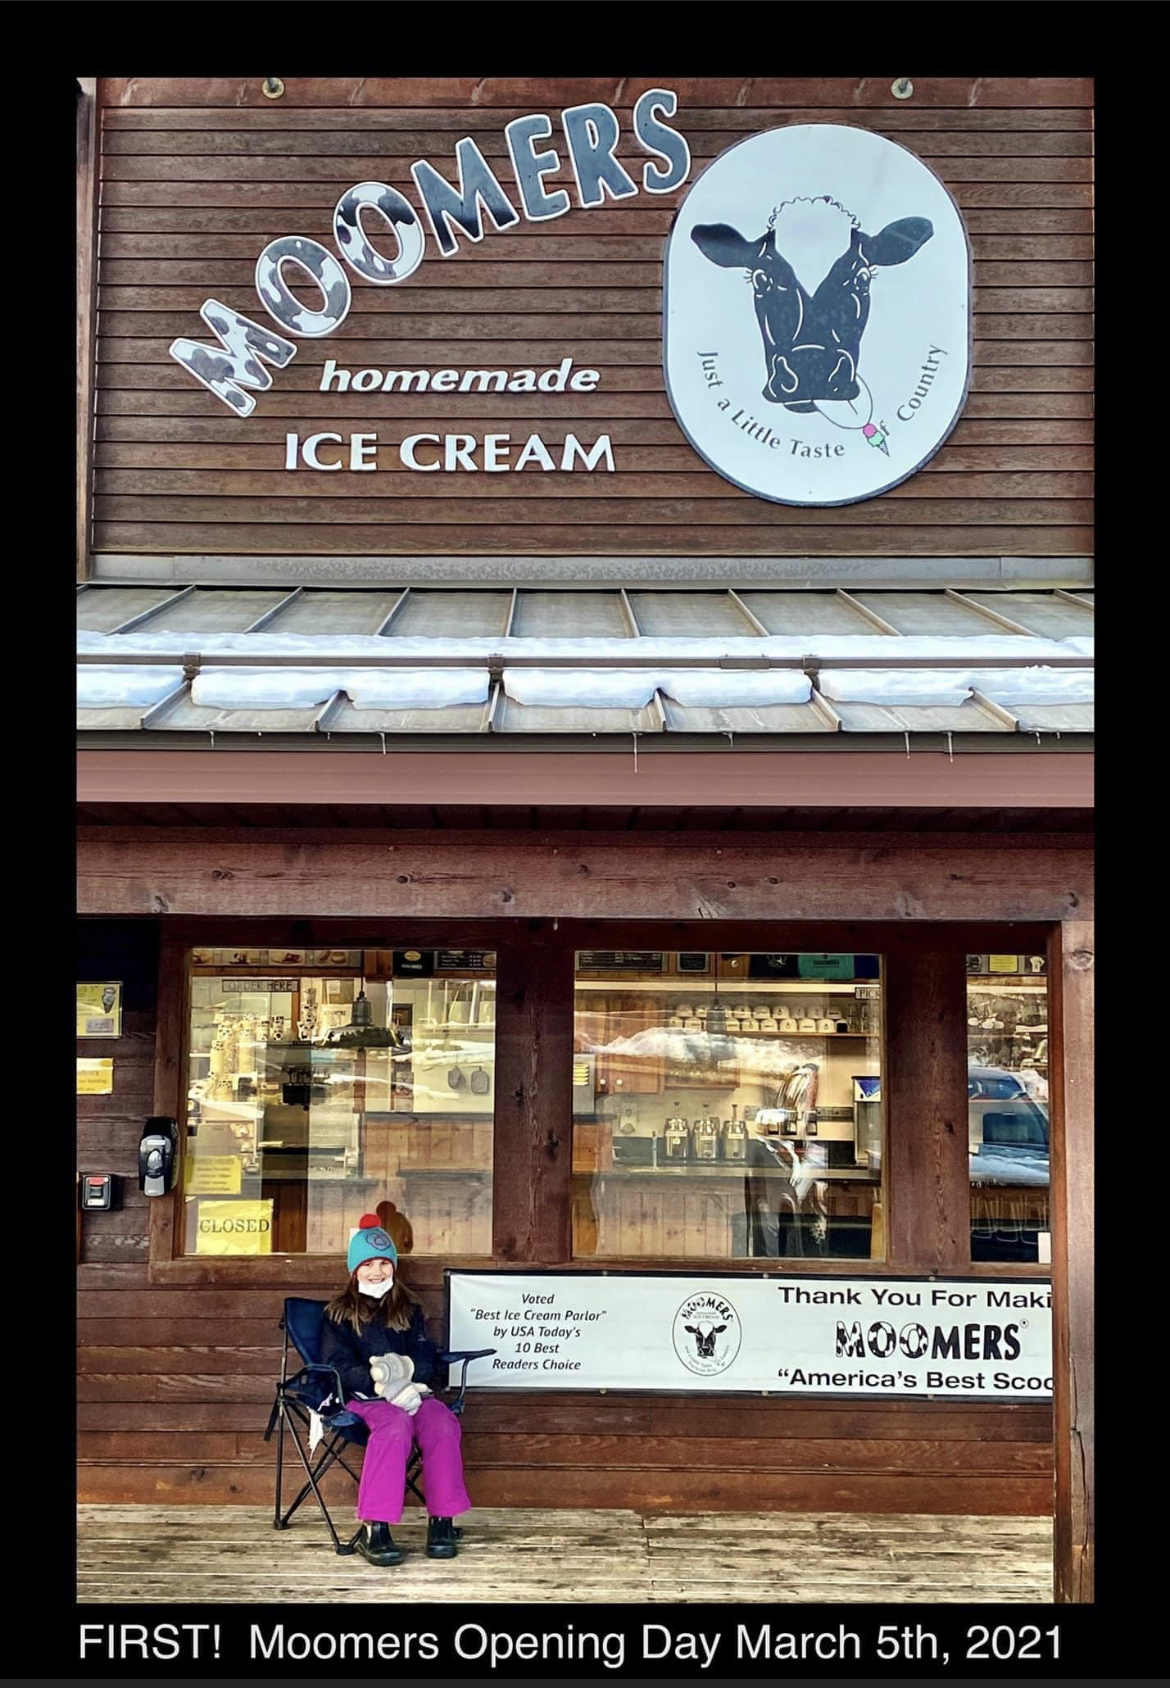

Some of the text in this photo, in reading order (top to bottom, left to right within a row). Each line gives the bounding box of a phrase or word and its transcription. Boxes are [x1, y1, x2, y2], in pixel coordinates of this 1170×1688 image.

[169, 88, 691, 418] MOOMERS
[319, 358, 600, 394] homemade
[697, 350, 724, 389] Just
[717, 397, 729, 411] a
[731, 407, 781, 449] Little
[790, 438, 845, 458] Taste
[897, 343, 949, 422] Country
[285, 432, 617, 472] ICE CREAM
[228, 982, 293, 992] ORDER HERE
[199, 1219, 270, 1233] CLOSED
[522, 1293, 554, 1305] Voted
[778, 1286, 1052, 1309] Thank You For Maki
[504, 1310, 521, 1321] Ice
[524, 1310, 561, 1321] Cream
[681, 1297, 734, 1321] MOOMERS
[493, 1326, 581, 1339] by USA Today's
[836, 1320, 1022, 1361] MOOMERS
[515, 1343, 559, 1354] 10 Best
[492, 1358, 581, 1370] Readers Choice
[926, 1371, 985, 1389] Best
